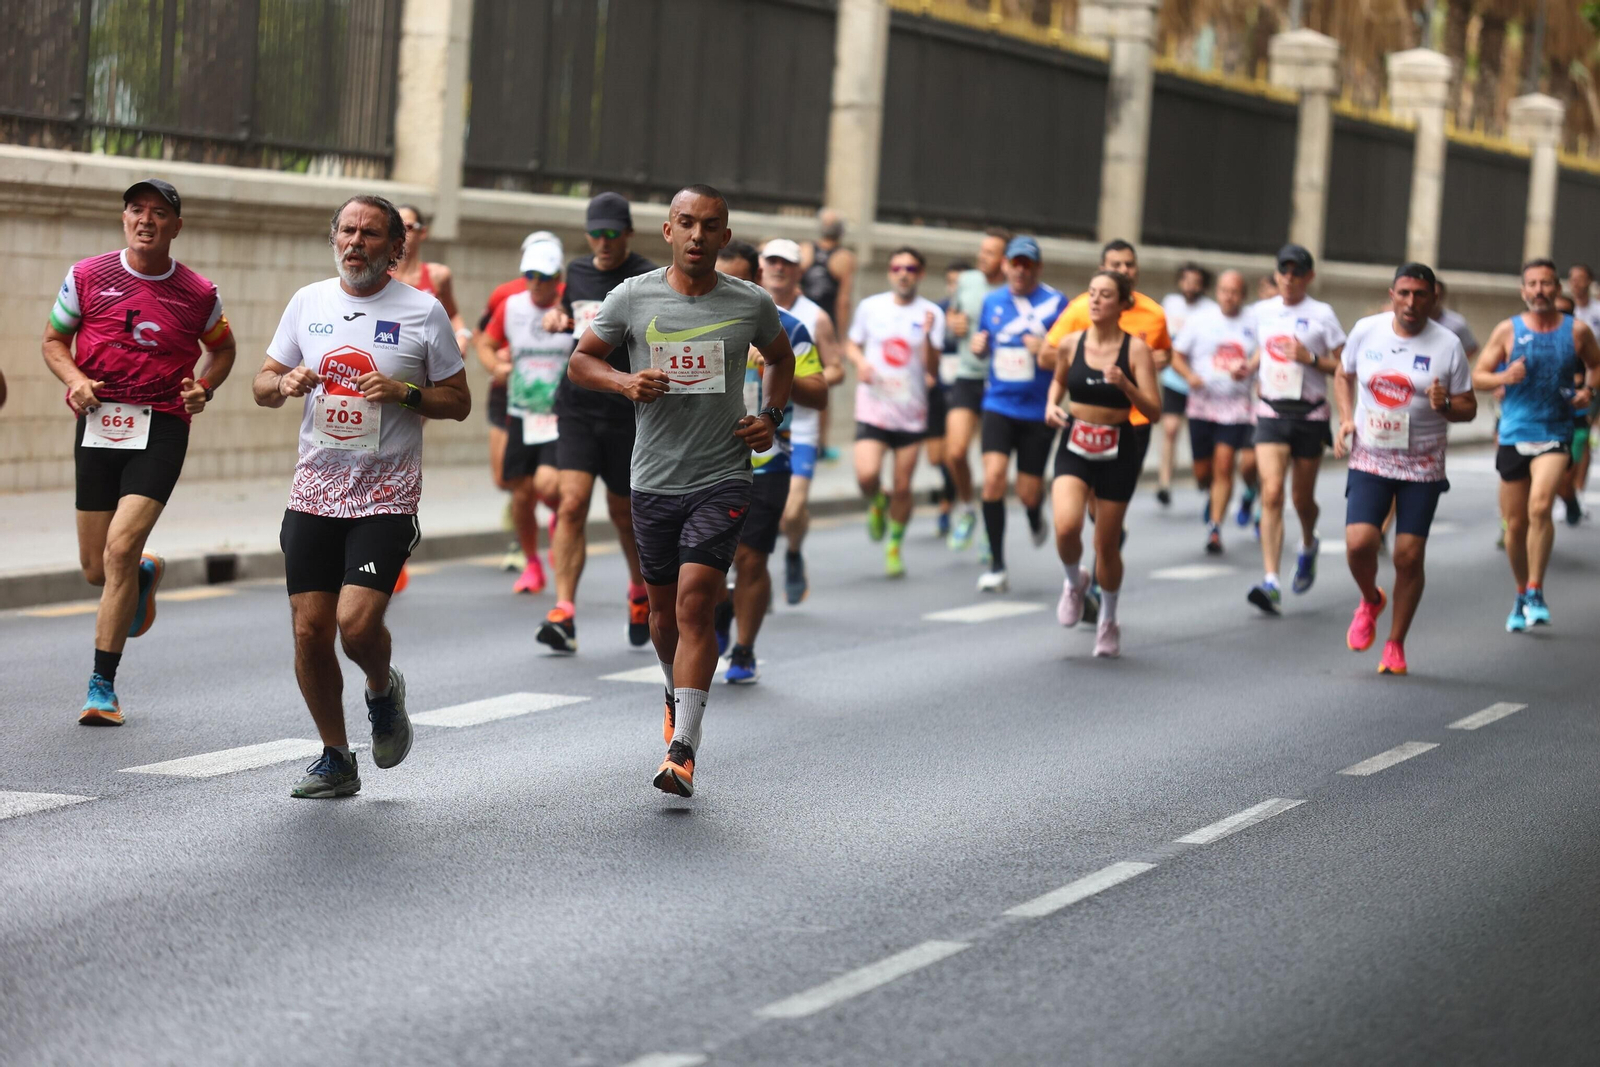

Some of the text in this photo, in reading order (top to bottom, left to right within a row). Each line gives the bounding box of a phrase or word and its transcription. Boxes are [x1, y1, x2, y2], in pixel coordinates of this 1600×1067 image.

[374, 331, 395, 343] AXA
[670, 355, 706, 369] 151
[326, 370, 364, 394] FREN
[101, 415, 134, 428] 664
[326, 409, 362, 424] 703
